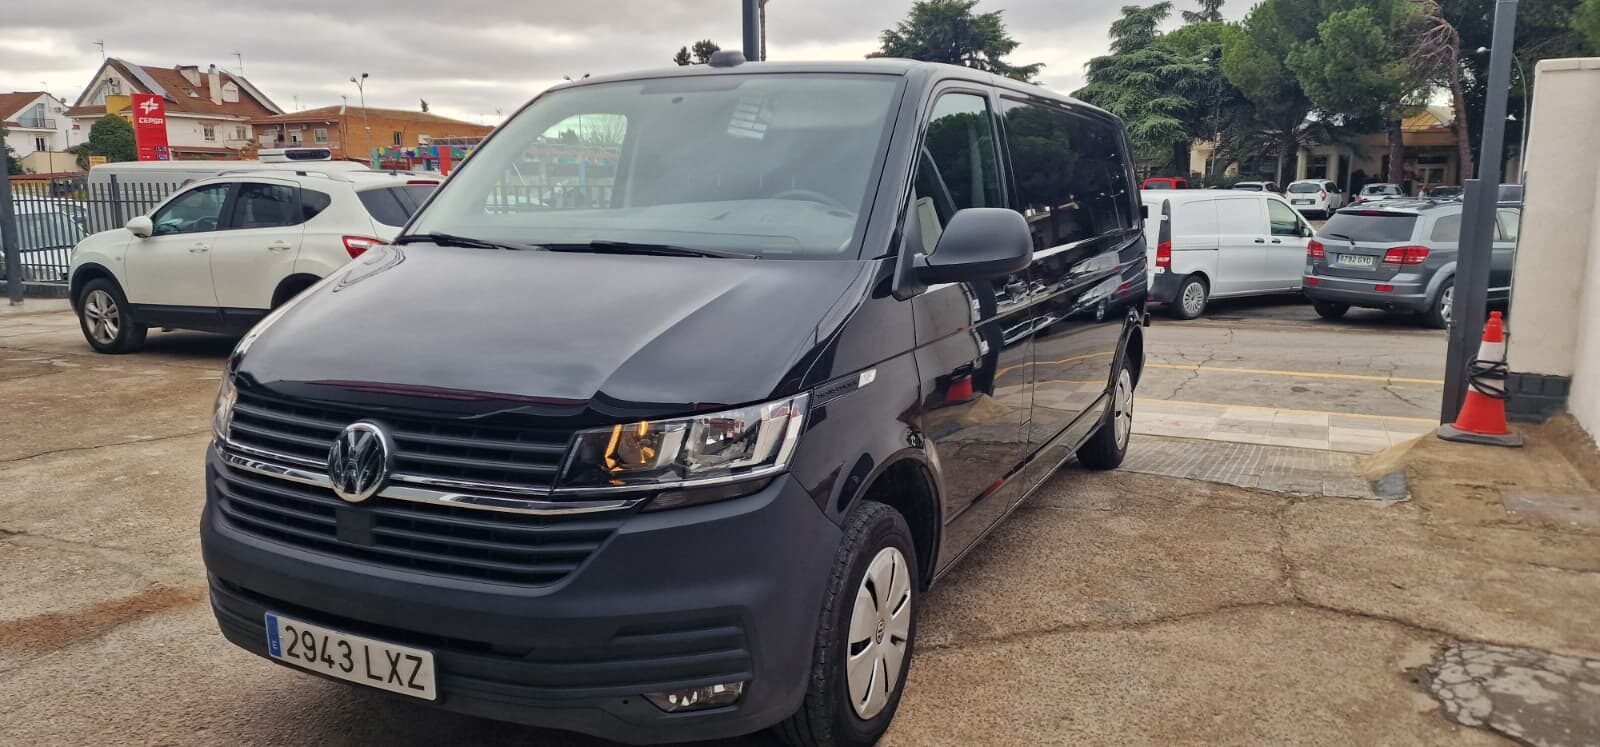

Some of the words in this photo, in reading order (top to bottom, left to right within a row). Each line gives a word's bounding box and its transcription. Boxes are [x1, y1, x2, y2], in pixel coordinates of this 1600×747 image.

[138, 117, 164, 125] CEPSA
[285, 625, 354, 673] 2943
[364, 645, 425, 691] LXZ
